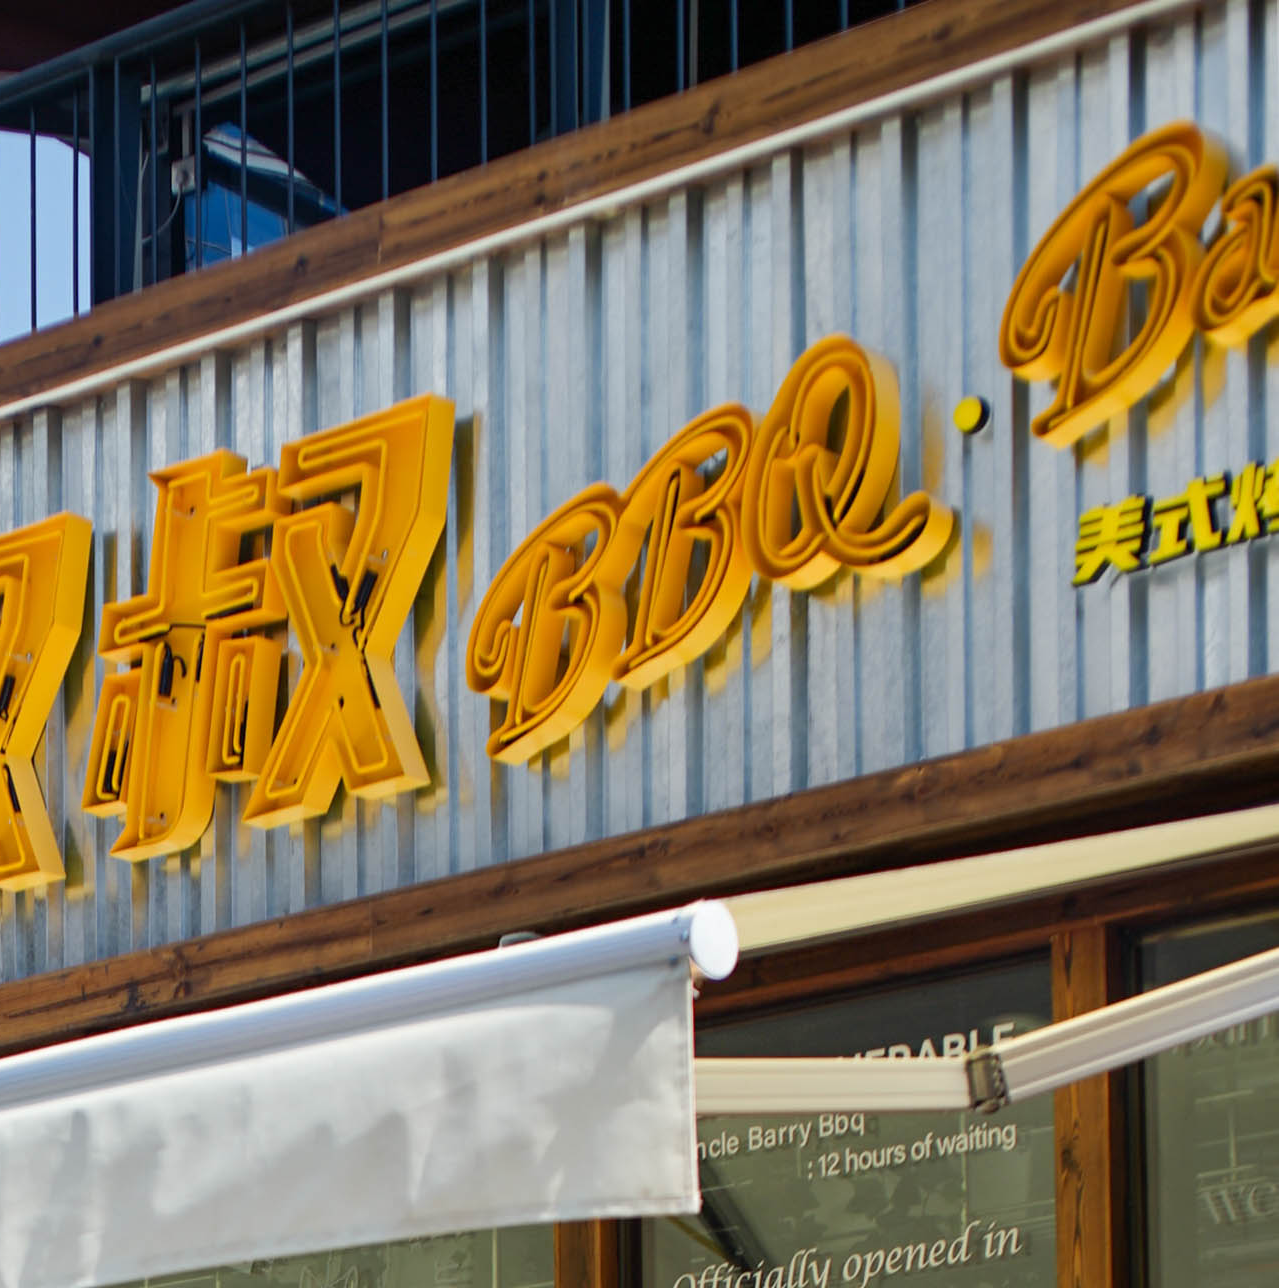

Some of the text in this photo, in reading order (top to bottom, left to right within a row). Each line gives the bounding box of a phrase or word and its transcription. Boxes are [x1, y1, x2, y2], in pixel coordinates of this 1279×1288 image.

[467, 332, 955, 764] BBQ
[697, 1112, 865, 1160] ncle Barry Bbq
[818, 1122, 1018, 1177] 12 hours of waiting
[984, 1222, 1023, 1258] in
